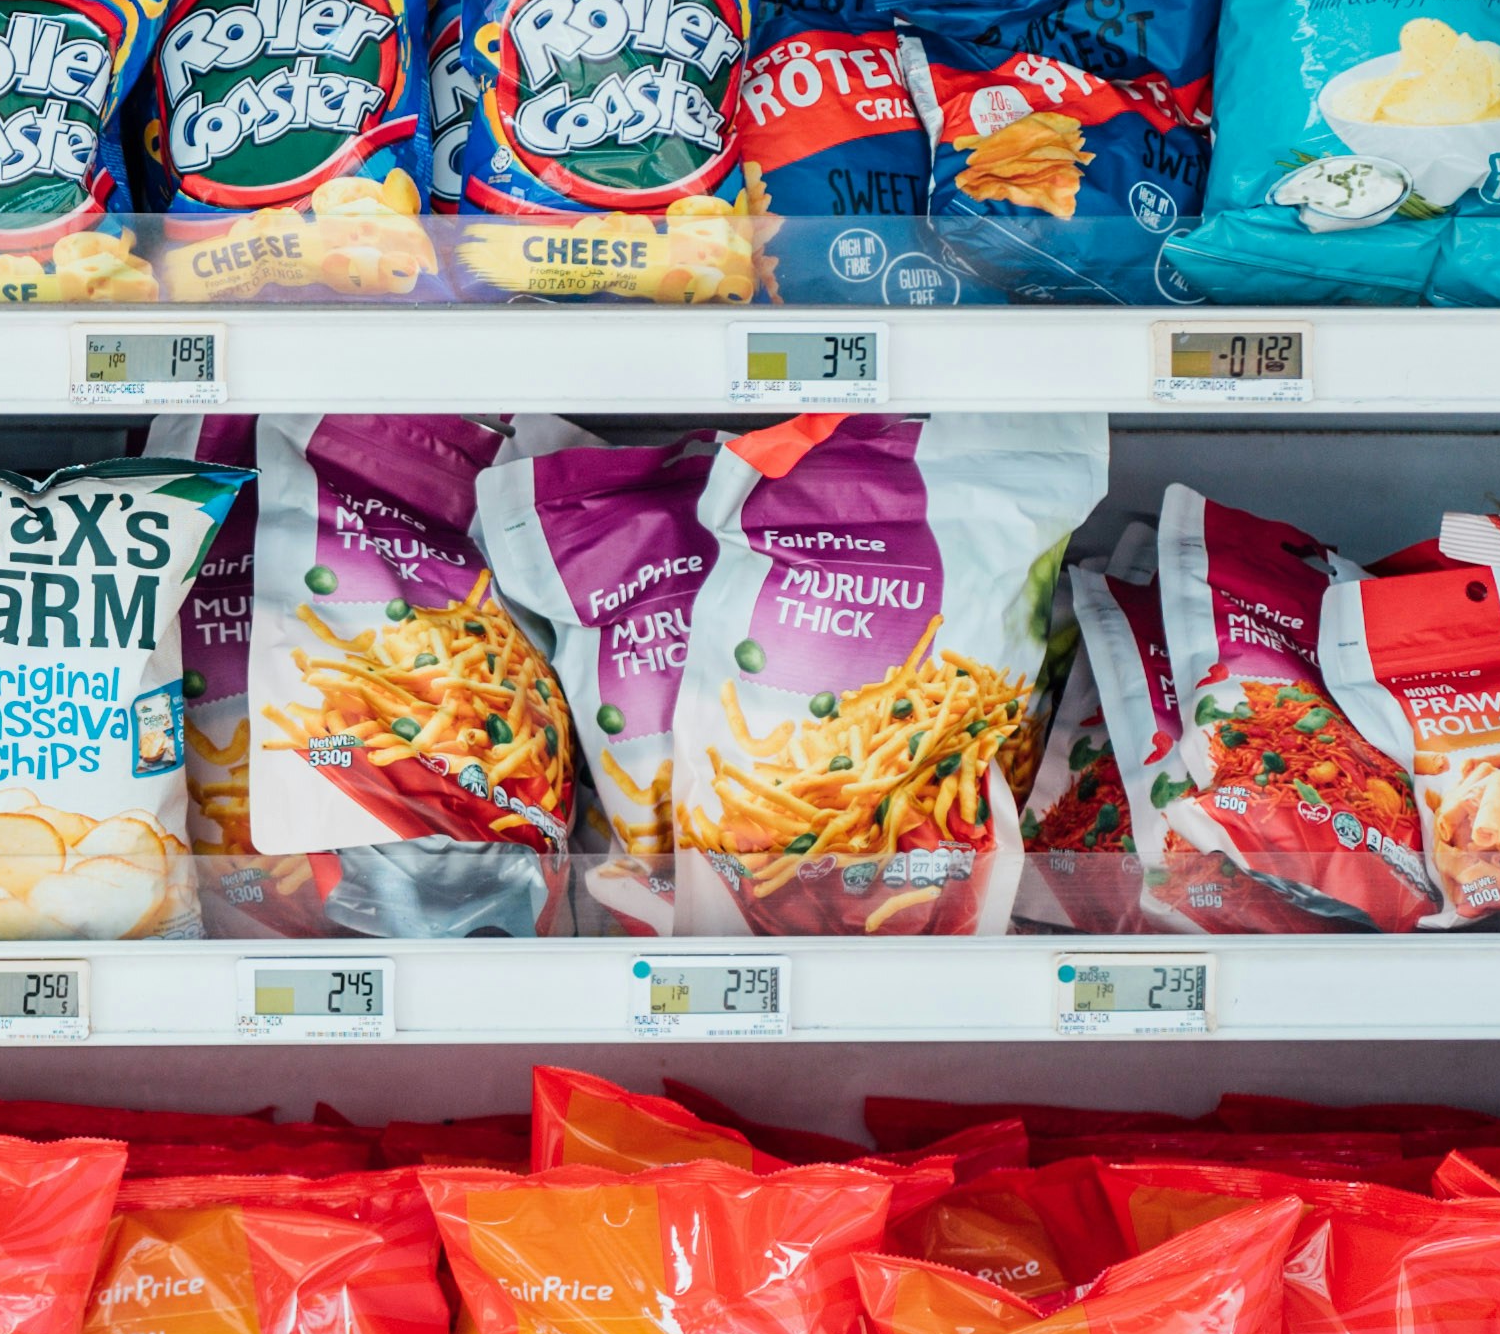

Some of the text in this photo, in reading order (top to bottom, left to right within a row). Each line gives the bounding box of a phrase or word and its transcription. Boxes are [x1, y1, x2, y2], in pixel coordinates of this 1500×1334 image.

[516, 62, 724, 156] Coaster
[829, 168, 921, 215] SWEET
[522, 237, 648, 268] CHEESE
[528, 277, 637, 290] POTATO RINGS
[764, 529, 886, 554] FairPrice
[781, 567, 926, 610] MURUKU
[777, 596, 874, 641] THICK
[309, 748, 352, 770] 330g
[1214, 794, 1248, 816] 150g
